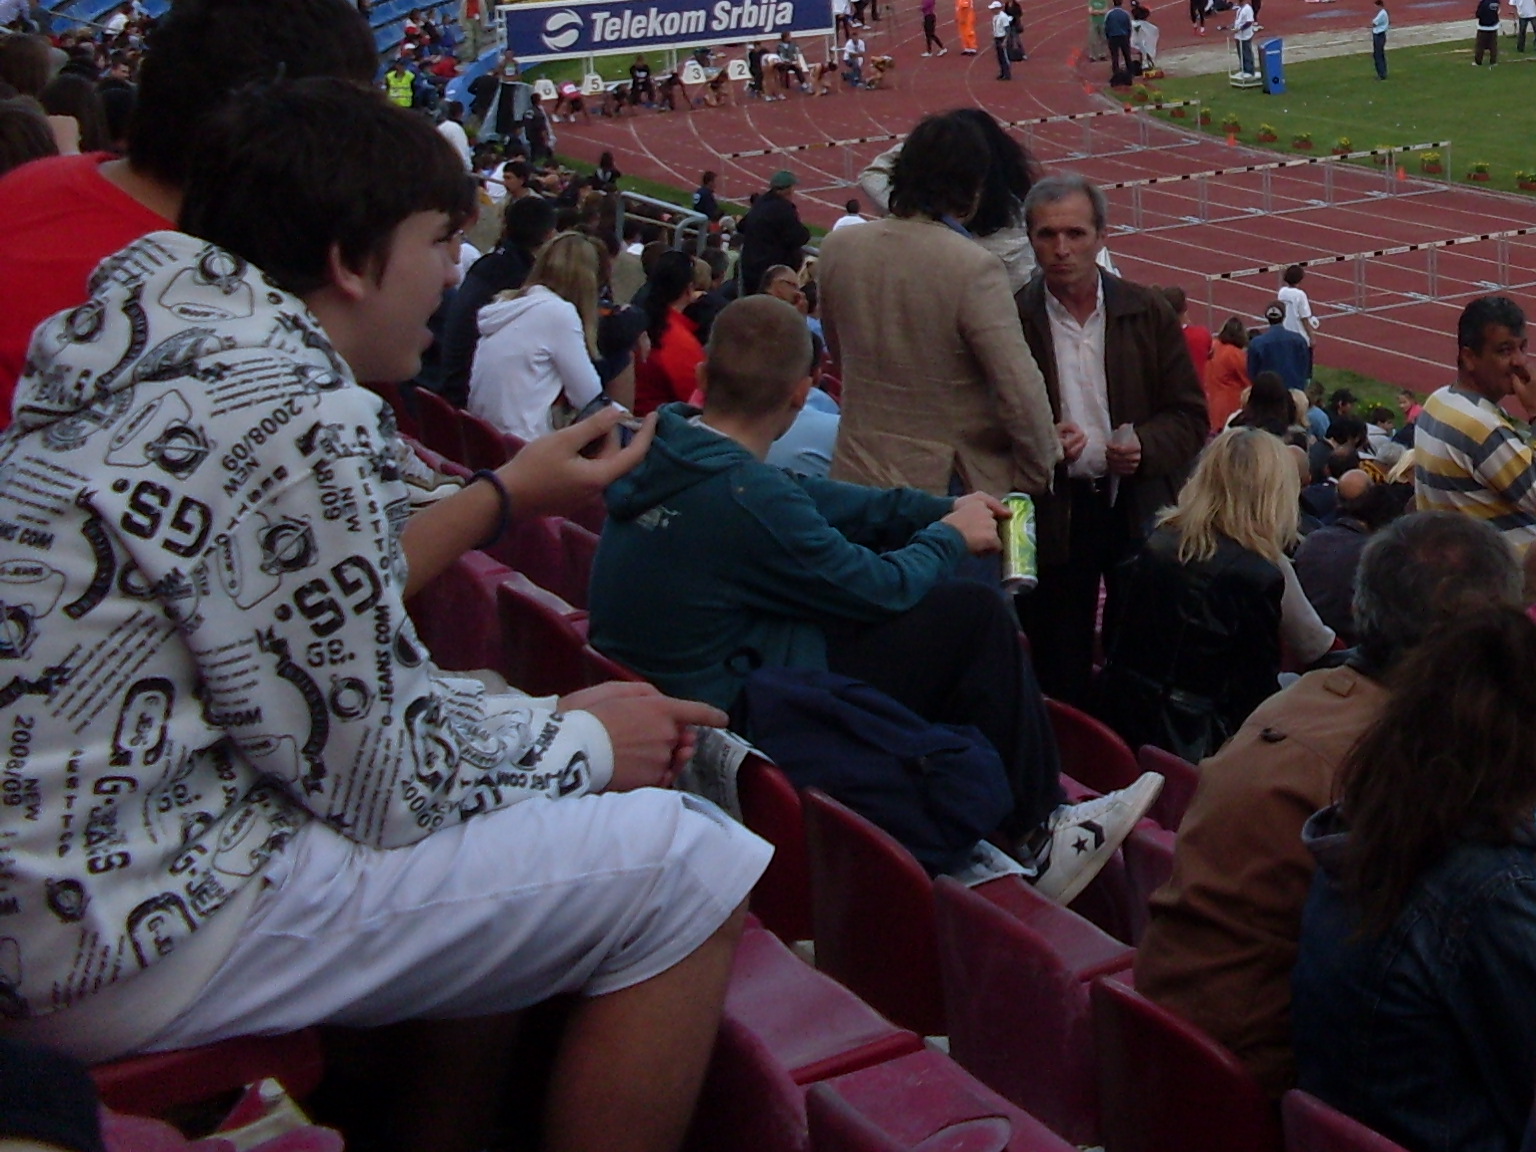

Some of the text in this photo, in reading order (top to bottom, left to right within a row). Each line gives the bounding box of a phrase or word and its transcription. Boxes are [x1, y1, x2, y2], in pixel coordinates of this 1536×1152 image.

[591, 7, 706, 43] Telekom
[591, 78, 600, 91] 5
[692, 67, 702, 81] 3
[737, 63, 746, 76] 2
[221, 397, 304, 473] 2008/09
[223, 455, 262, 498] NEW
[3, 715, 35, 807] 2008/09
